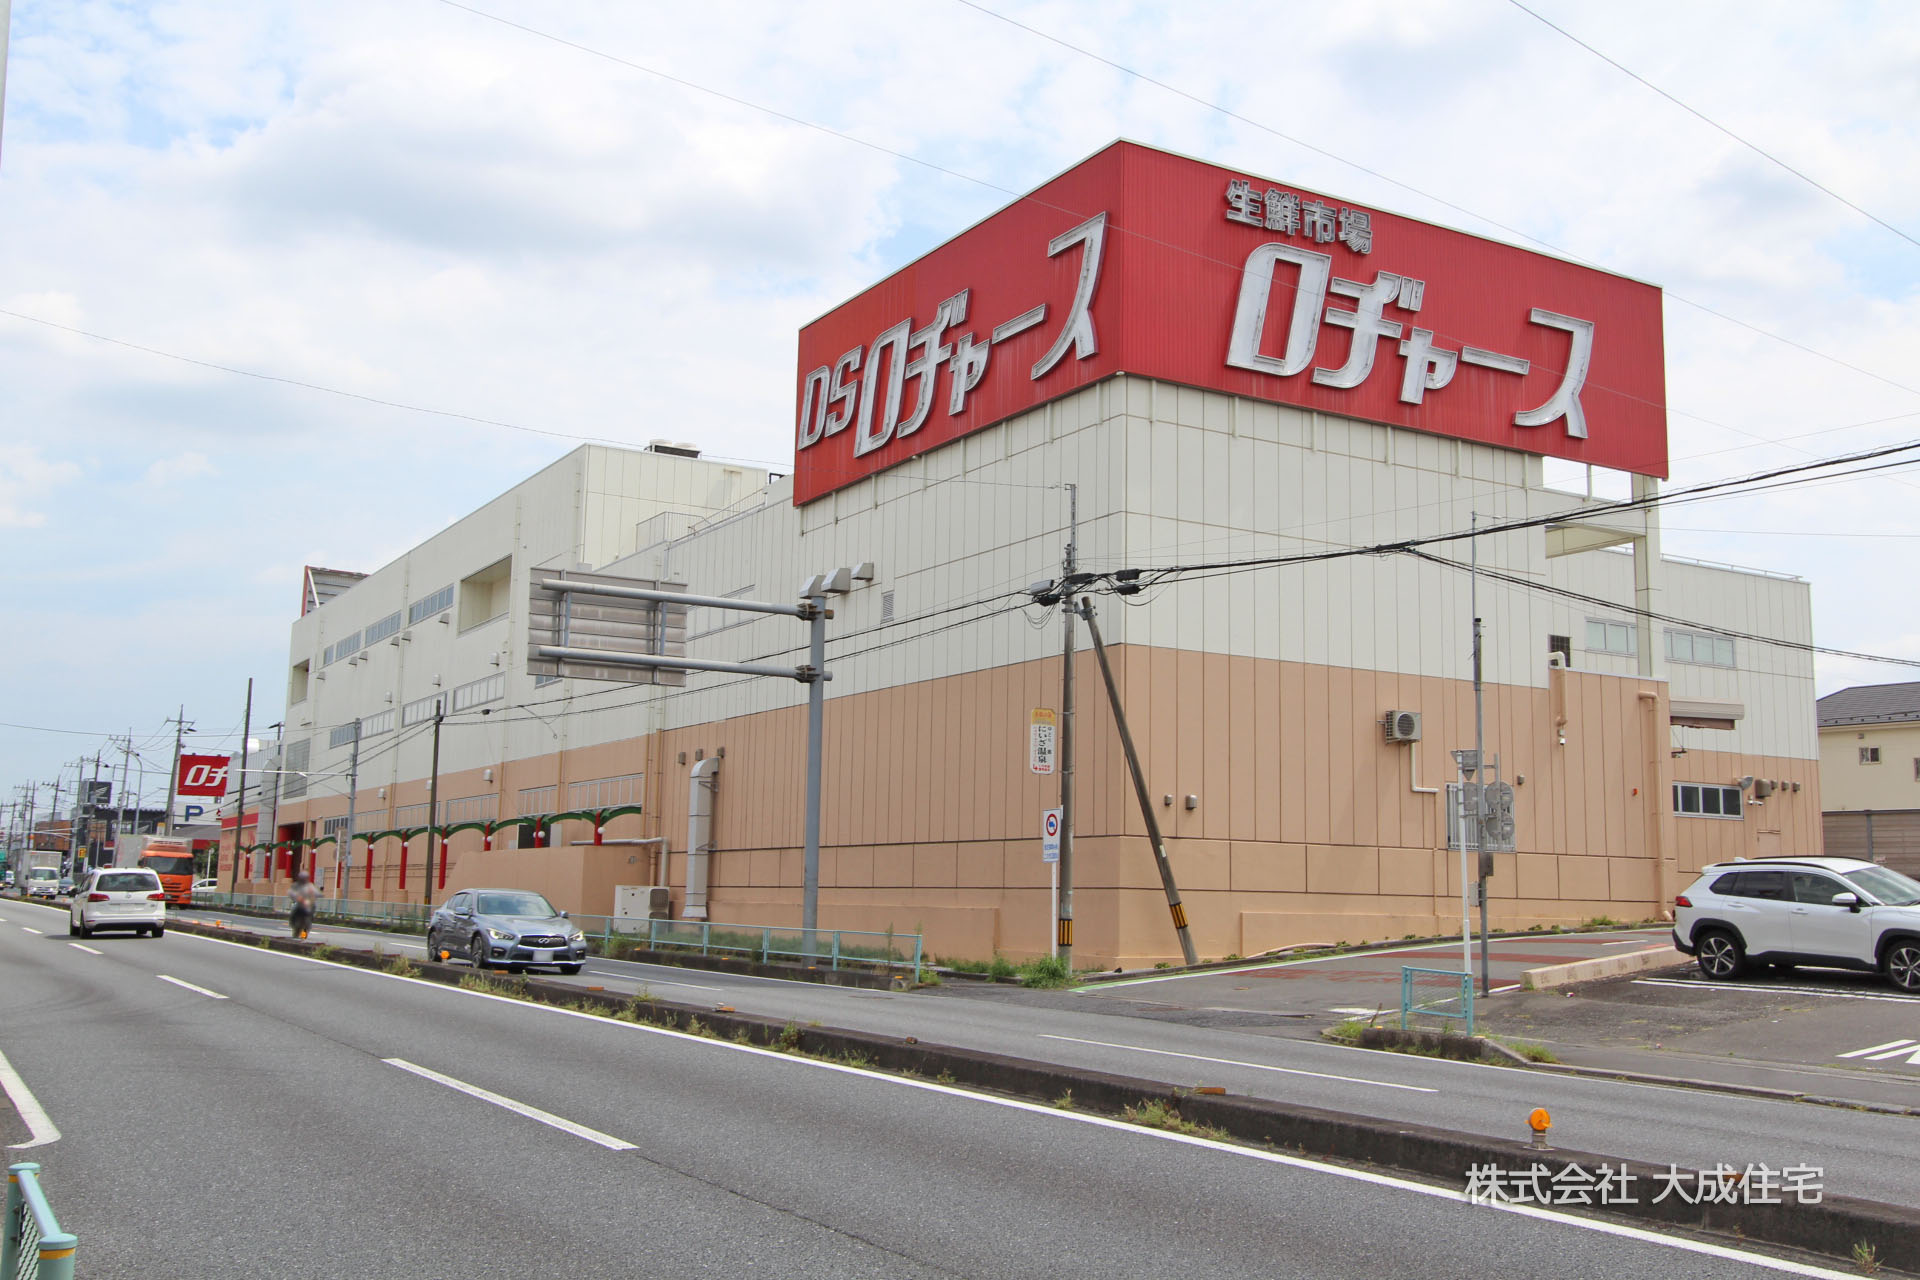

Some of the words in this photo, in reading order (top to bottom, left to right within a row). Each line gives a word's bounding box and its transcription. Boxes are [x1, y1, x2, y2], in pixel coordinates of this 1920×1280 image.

[1225, 179, 1373, 255] 生鮮市場
[1226, 242, 1595, 440] ロギャース
[185, 805, 204, 822] P
